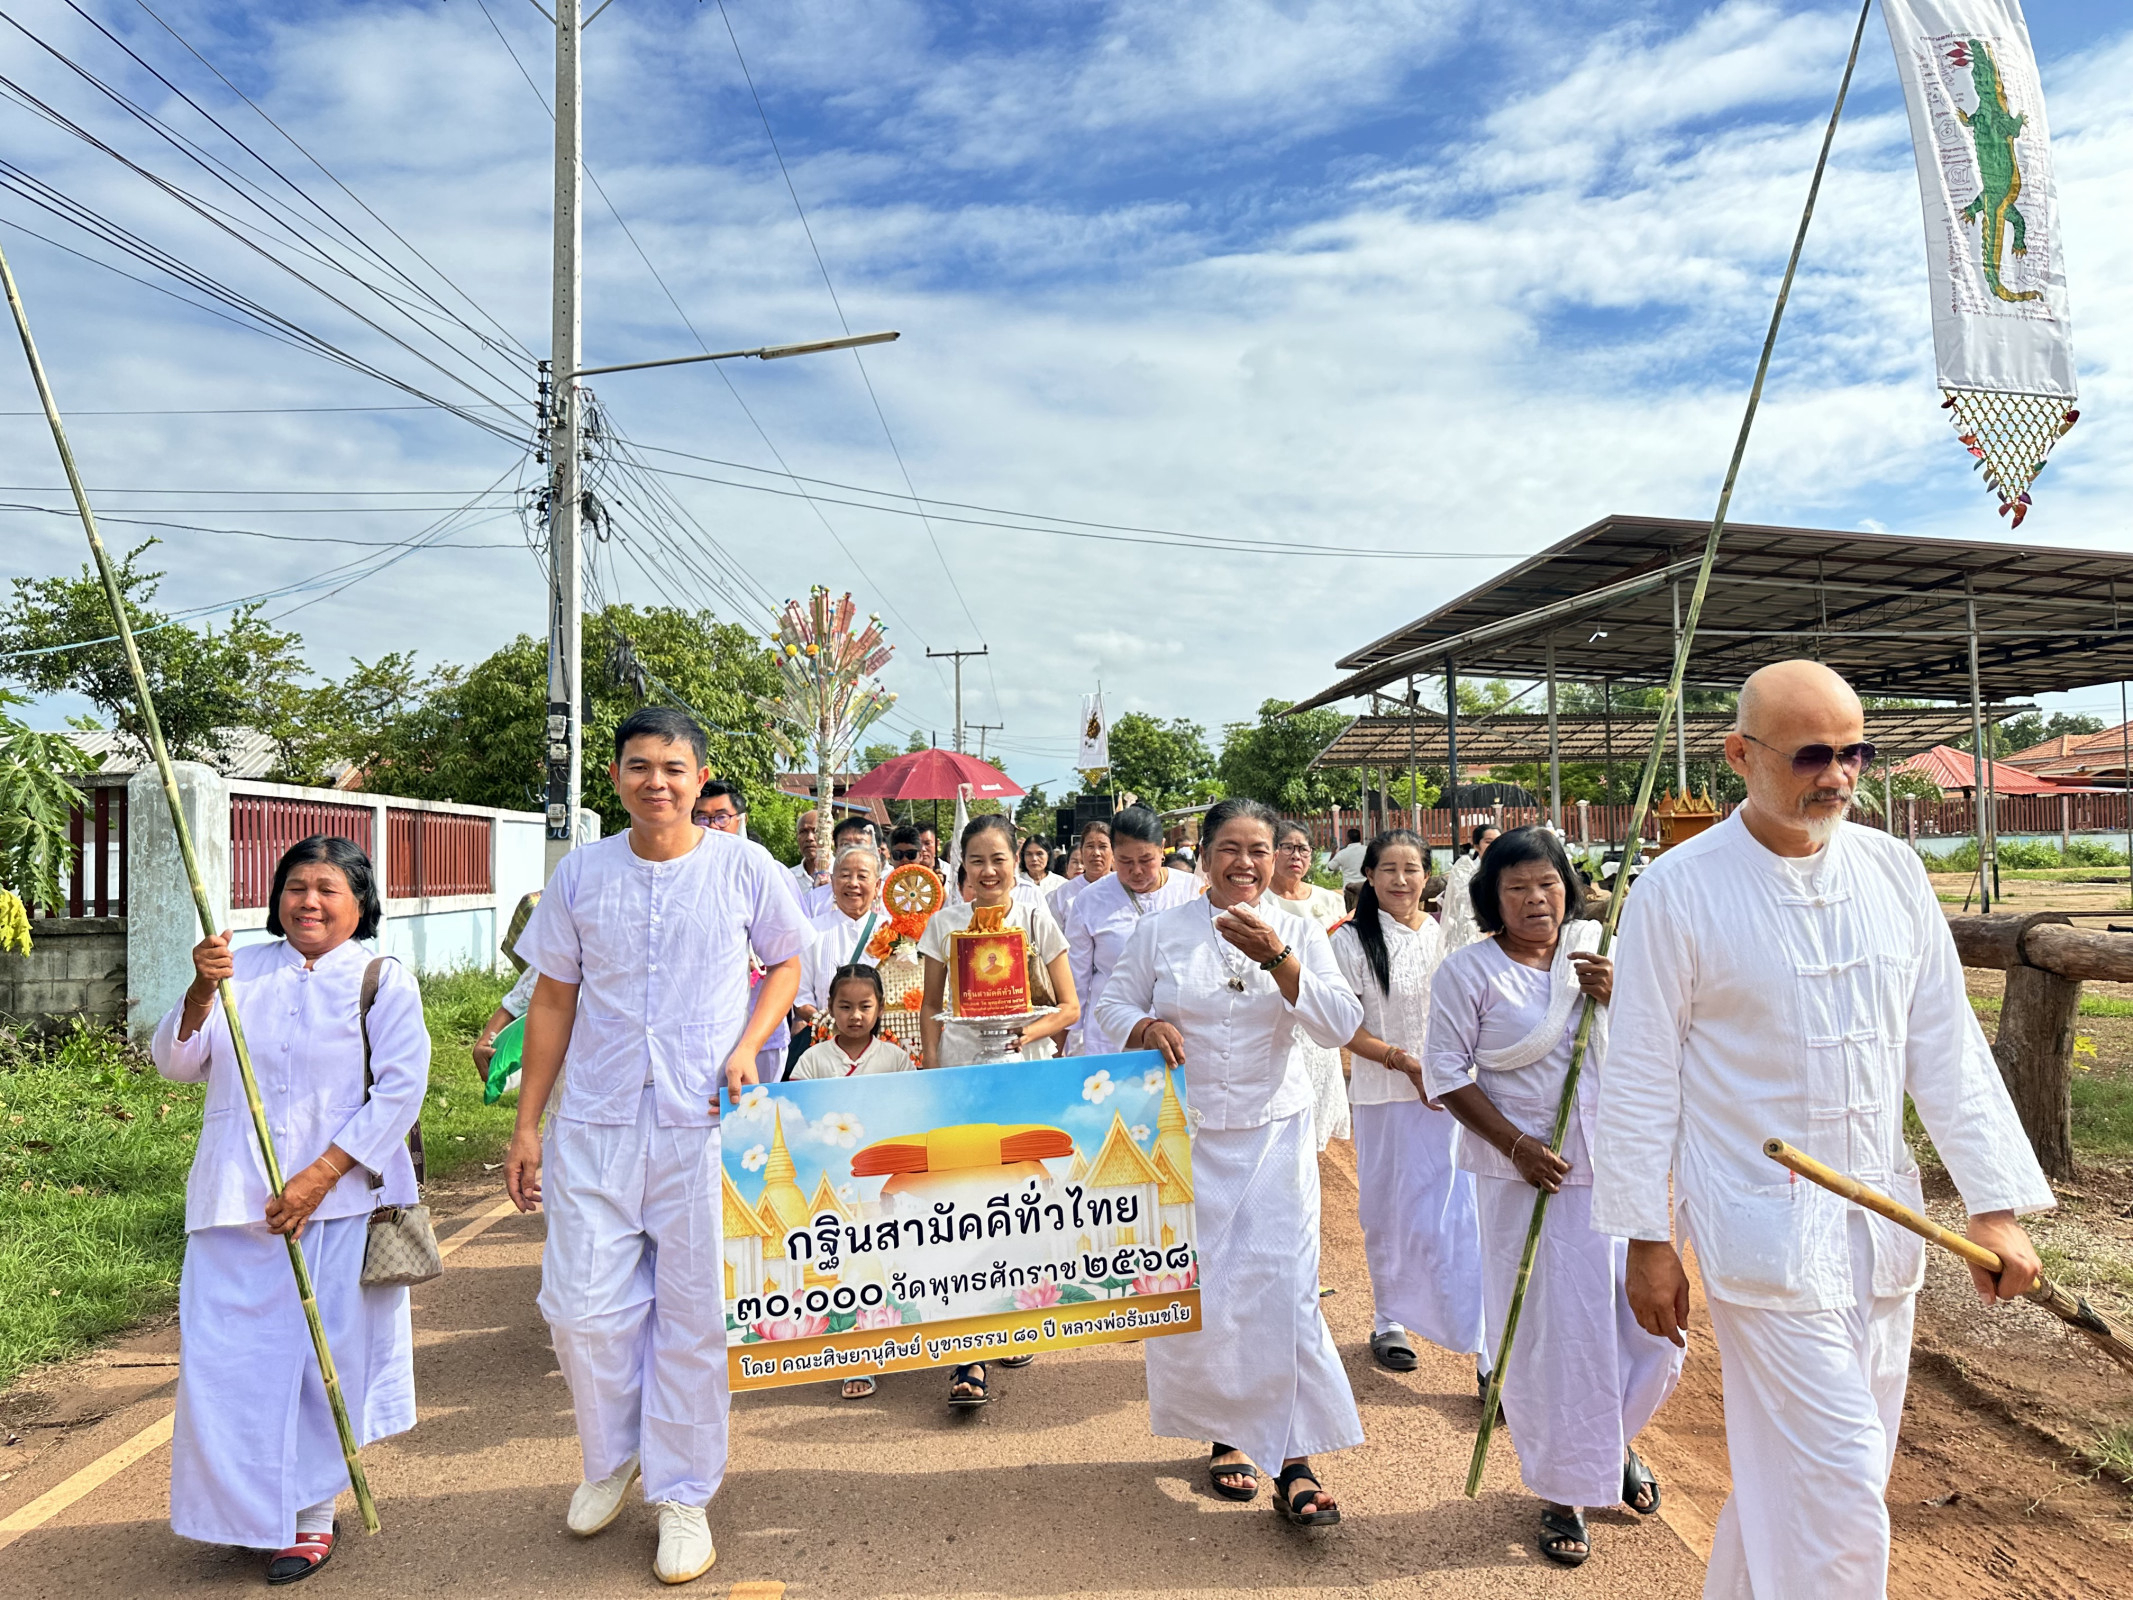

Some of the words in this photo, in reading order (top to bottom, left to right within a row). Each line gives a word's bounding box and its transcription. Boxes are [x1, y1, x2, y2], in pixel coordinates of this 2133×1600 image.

[787, 1180, 1138, 1271] กฐินสามัคคีทั่วไทย
[737, 1283, 883, 1321] ๓๐,๐๐๐
[1082, 1242, 1189, 1279] ๒๕๖๘
[741, 1357, 775, 1376] โดย
[782, 1335, 920, 1372] คณะศิษยานุศิษย์
[927, 1331, 1008, 1359] บูชาธรรม
[1012, 1328, 1039, 1343] ๘๑
[1043, 1319, 1056, 1338] ปี
[1061, 1303, 1190, 1336] หลวงพ่อธัมมชโย
